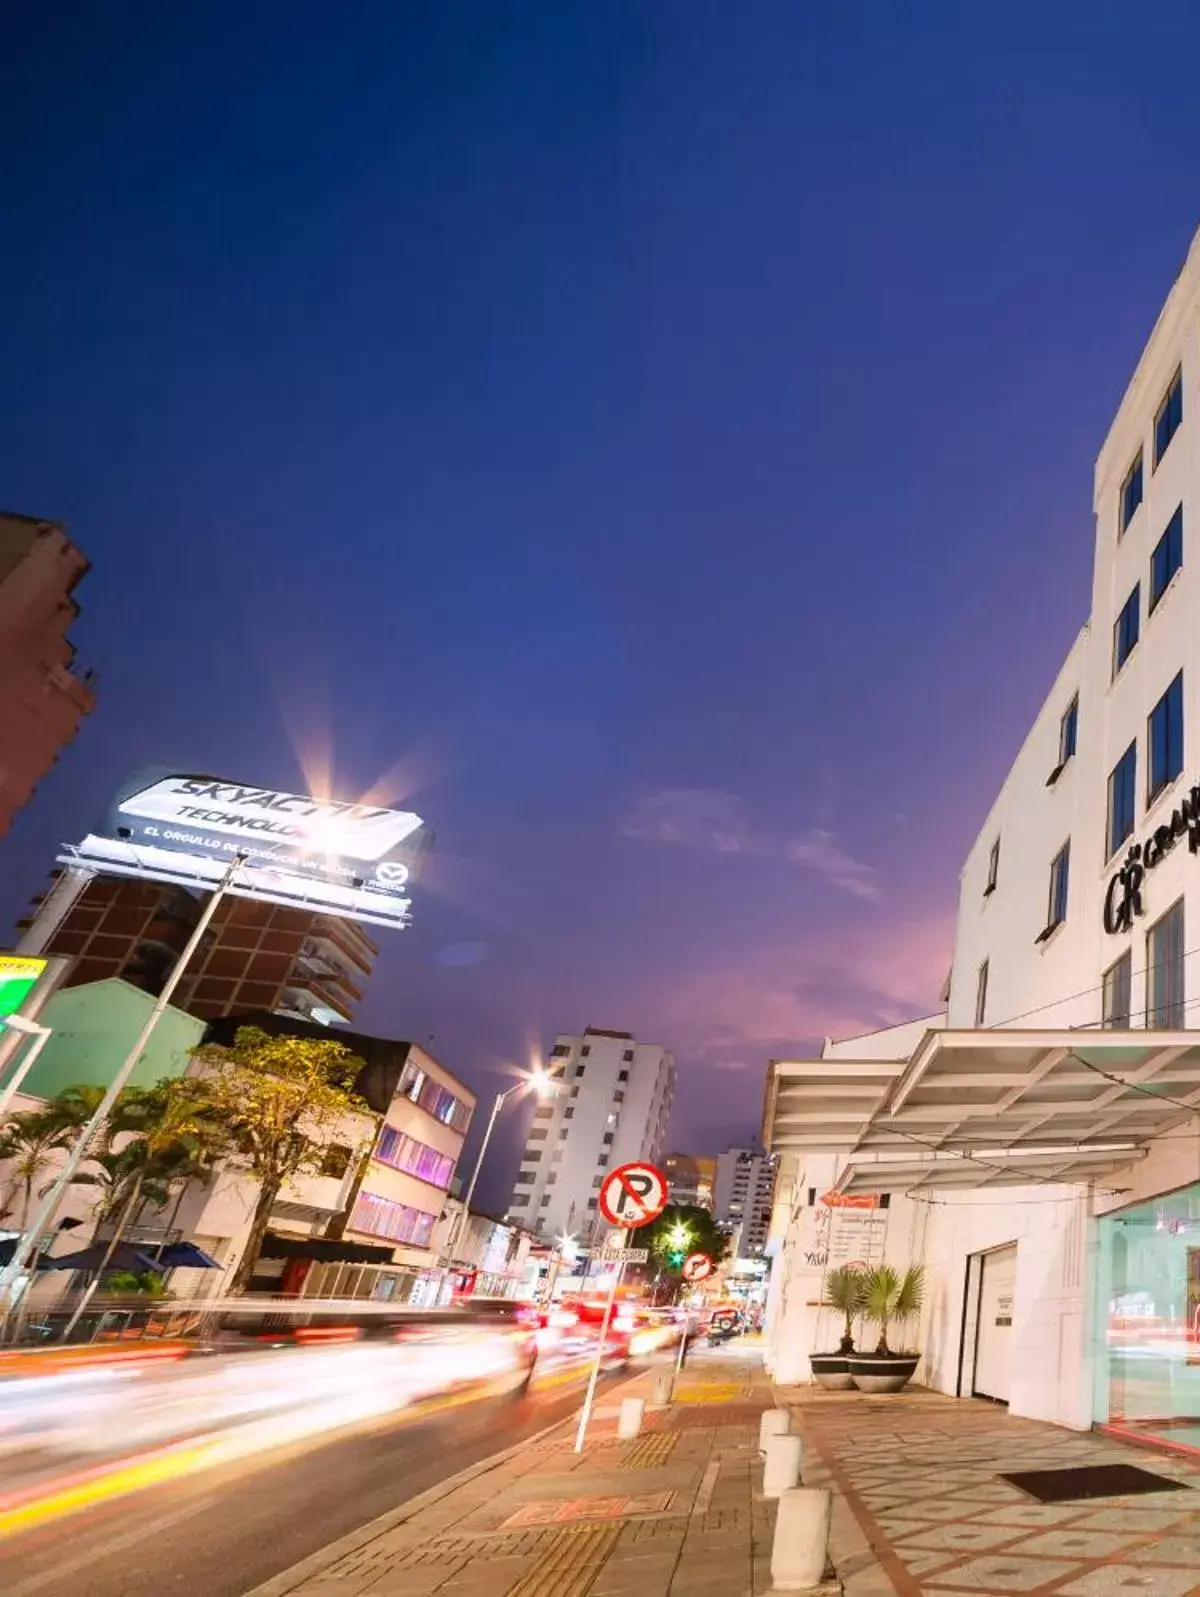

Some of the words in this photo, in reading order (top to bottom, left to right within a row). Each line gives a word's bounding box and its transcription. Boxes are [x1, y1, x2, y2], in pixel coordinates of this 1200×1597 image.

[143, 826, 160, 837] EL
[163, 831, 221, 849] ORGULLO
[223, 842, 240, 852] DE
[616, 1174, 653, 1213] P
